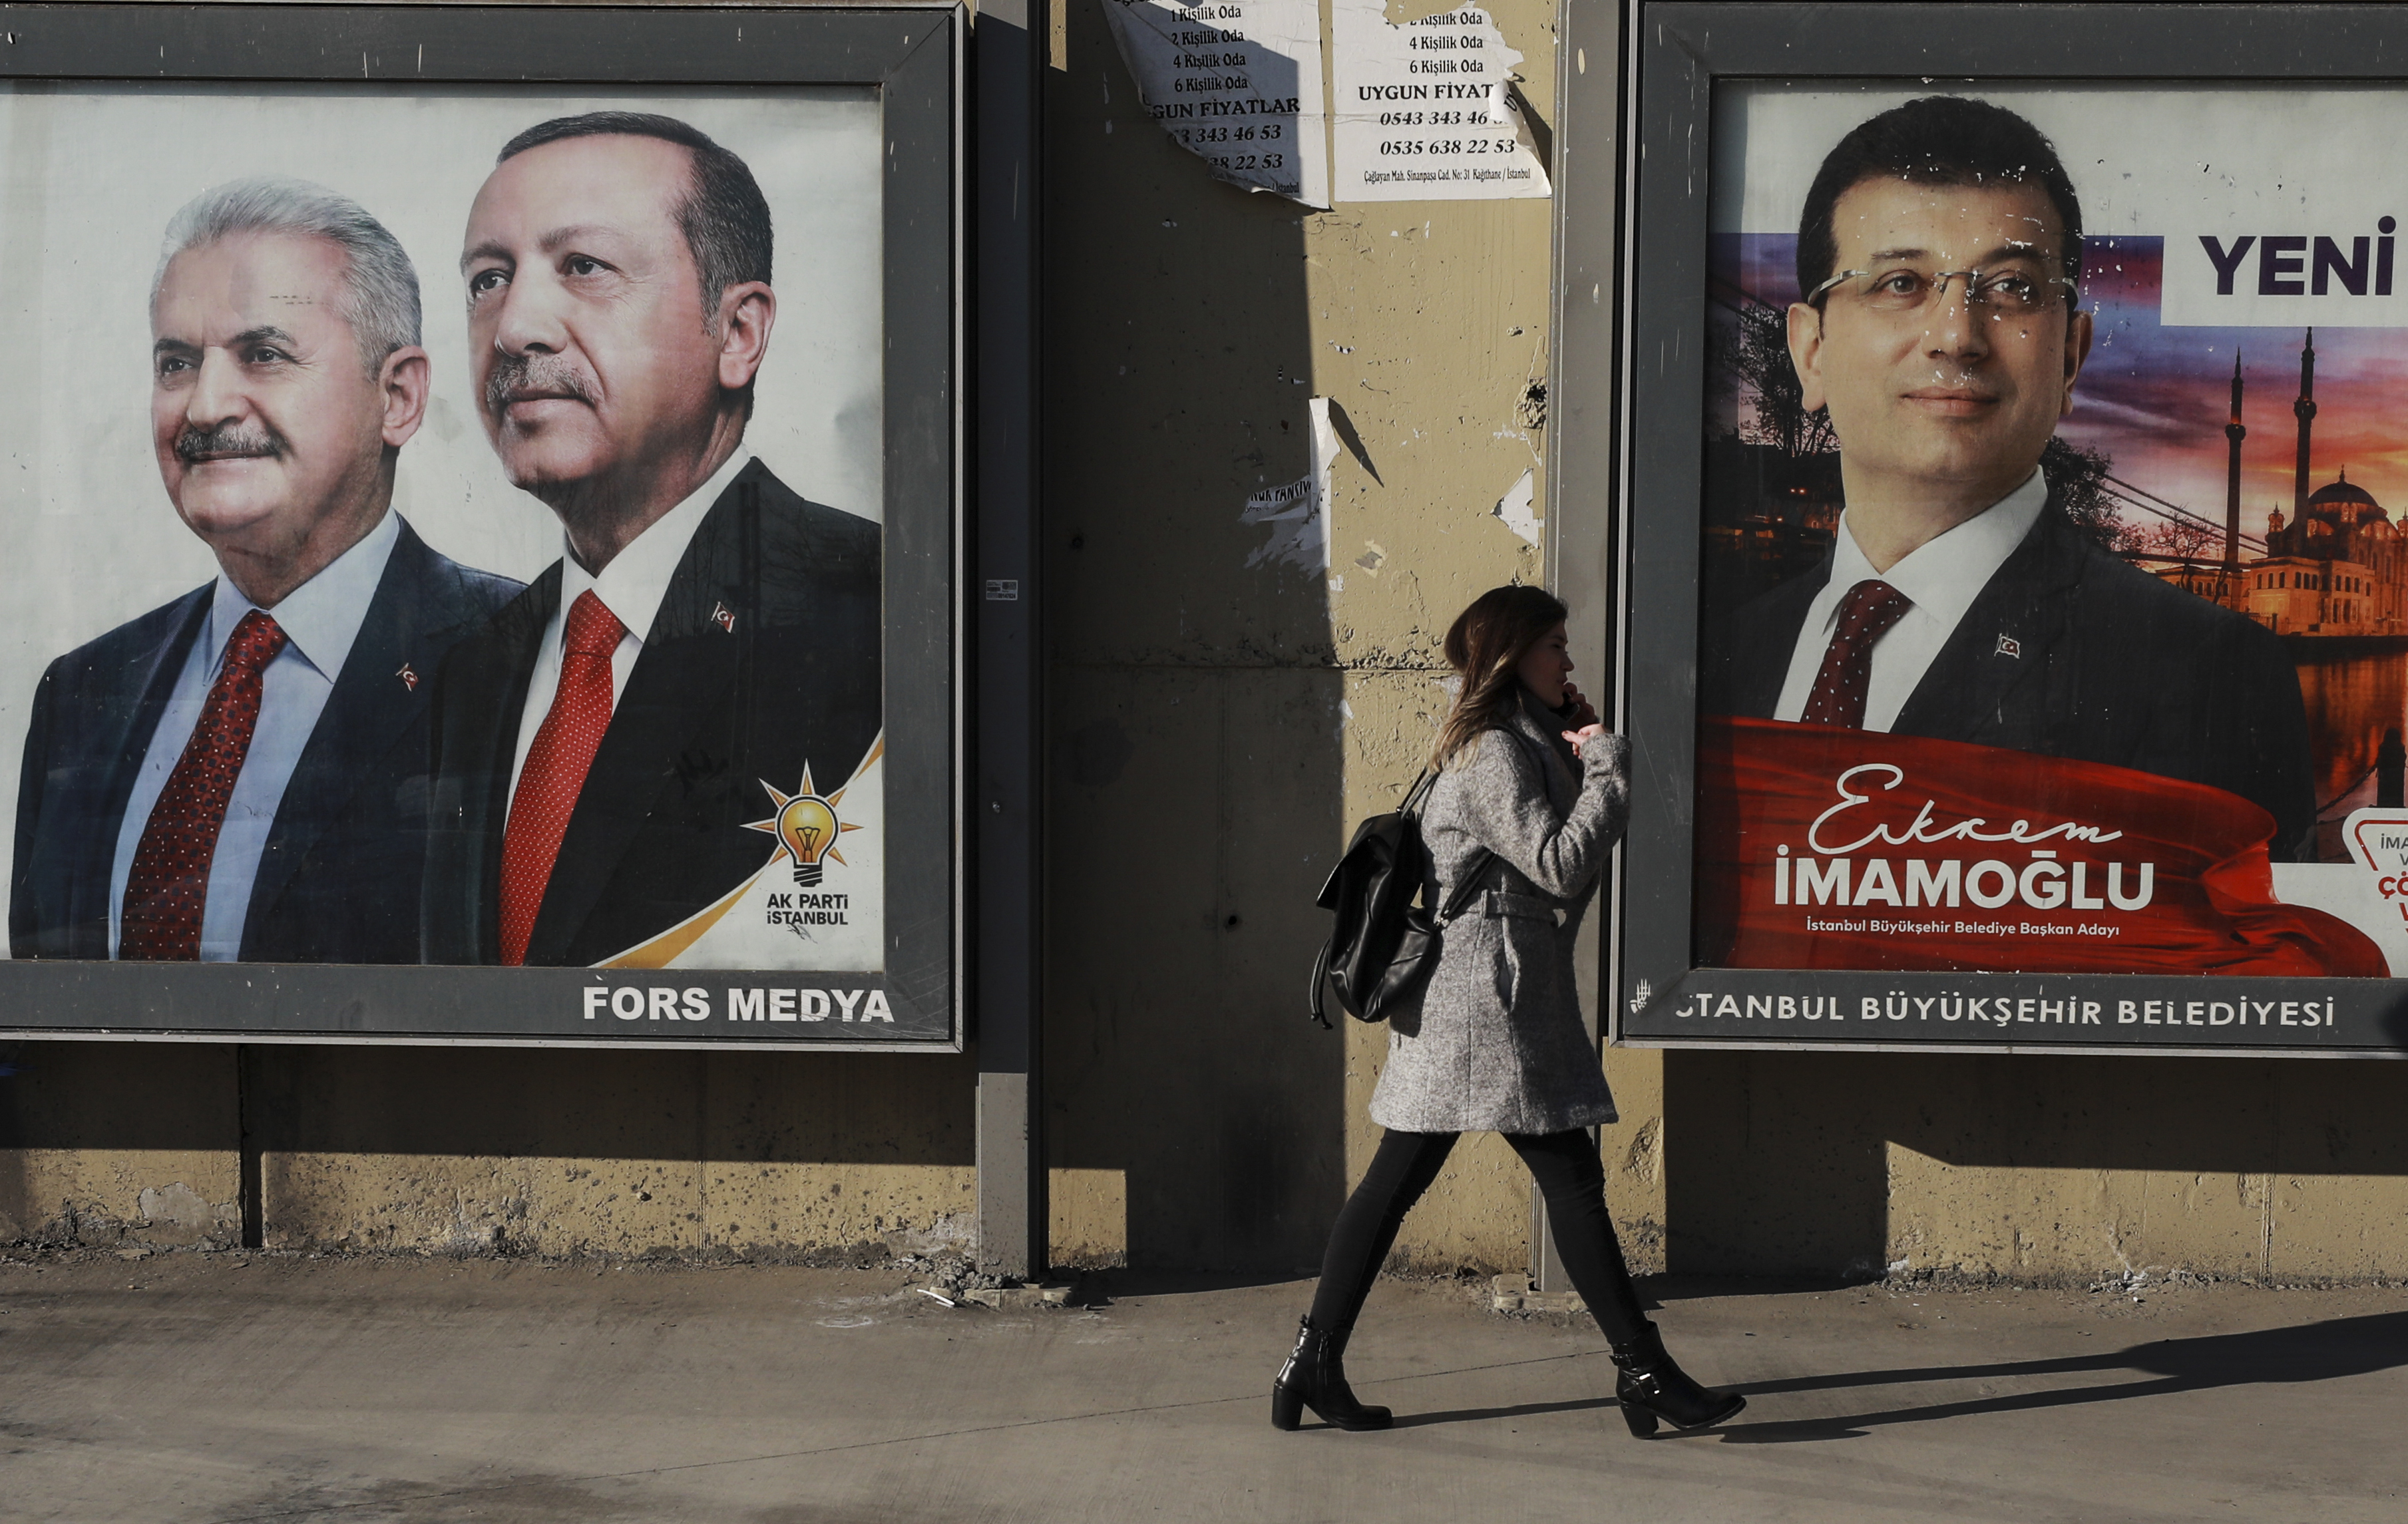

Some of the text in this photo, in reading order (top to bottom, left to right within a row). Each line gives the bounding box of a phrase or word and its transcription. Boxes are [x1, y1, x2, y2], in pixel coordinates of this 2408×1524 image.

[1171, 5, 1241, 25] 1 Kişilik Oda
[1460, 12, 1482, 25] Oda
[1171, 29, 1244, 47] 2 Kişilik Oda
[1410, 36, 1483, 52] 4 Kişilik Oda
[1173, 53, 1246, 70] 4 Kişilik Oda
[1410, 59, 1484, 76] 6 Kişilik Oda
[1175, 76, 1247, 94] 6 Kişilik Oda
[1358, 85, 1428, 100] UYGUN
[1200, 98, 1301, 117] FİYATLAR
[1380, 112, 1423, 126] 0543
[1428, 111, 1461, 124] 343
[1467, 110, 1489, 124] 46
[1195, 127, 1228, 143] 343
[1233, 126, 1255, 141] 46
[1260, 124, 1282, 140] 53
[1380, 139, 1515, 156] 0535 638 22 53
[1235, 155, 1257, 170] 22
[1262, 154, 1283, 169] 53
[1364, 170, 1390, 185] Çağlayan
[1507, 166, 1531, 179] İstanbul
[2198, 216, 2396, 295] YENİ
[1808, 763, 2122, 855] Ekrem
[1774, 844, 2154, 910] İMAMOĞLU
[767, 893, 793, 909] AK
[1806, 916, 2120, 937] İstanbul Büyükşehir Belediye Başkan Adayı
[583, 986, 895, 1023] FORS MEDYA
[1861, 990, 2101, 1027] BÜYÜKŞEHİR
[2117, 996, 2334, 1027] BELEDİYESİ
